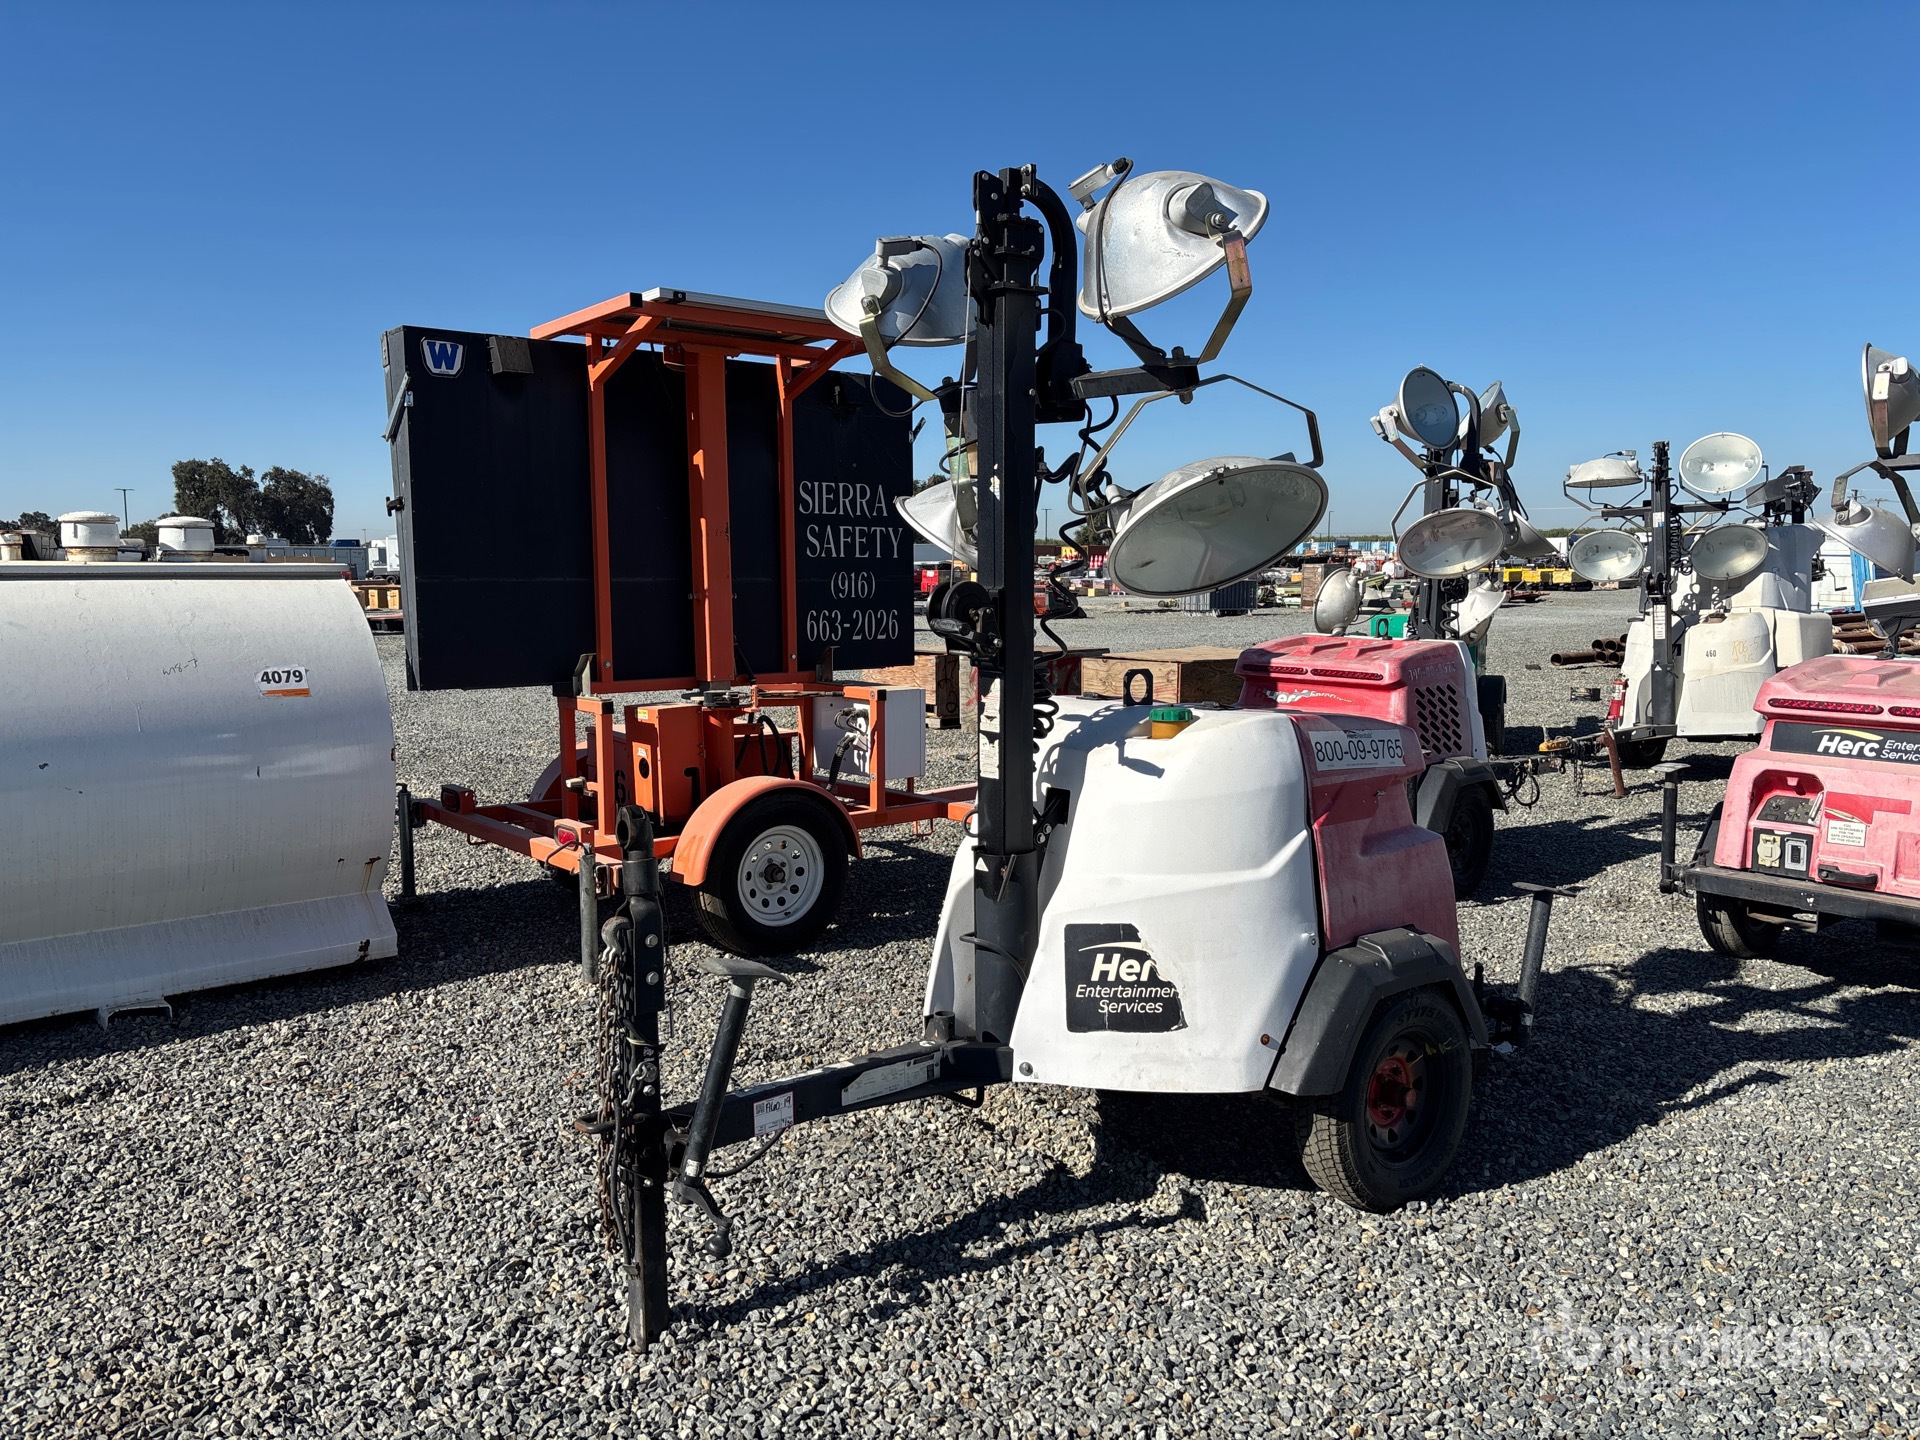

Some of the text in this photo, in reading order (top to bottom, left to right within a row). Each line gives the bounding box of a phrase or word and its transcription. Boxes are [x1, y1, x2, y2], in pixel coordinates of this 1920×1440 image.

[427, 341, 459, 371] W
[799, 480, 889, 519] SIERRA
[806, 524, 904, 559] SAFETY
[831, 571, 876, 600] (916)
[806, 609, 899, 642] 663-2026
[261, 670, 304, 685] 4079
[1314, 739, 1403, 762] 800-09-9765
[1816, 734, 1920, 757] Herc Enter
[1880, 749, 1920, 762] Servic
[1090, 953, 1159, 982] Her
[1098, 1000, 1164, 1014] Services
